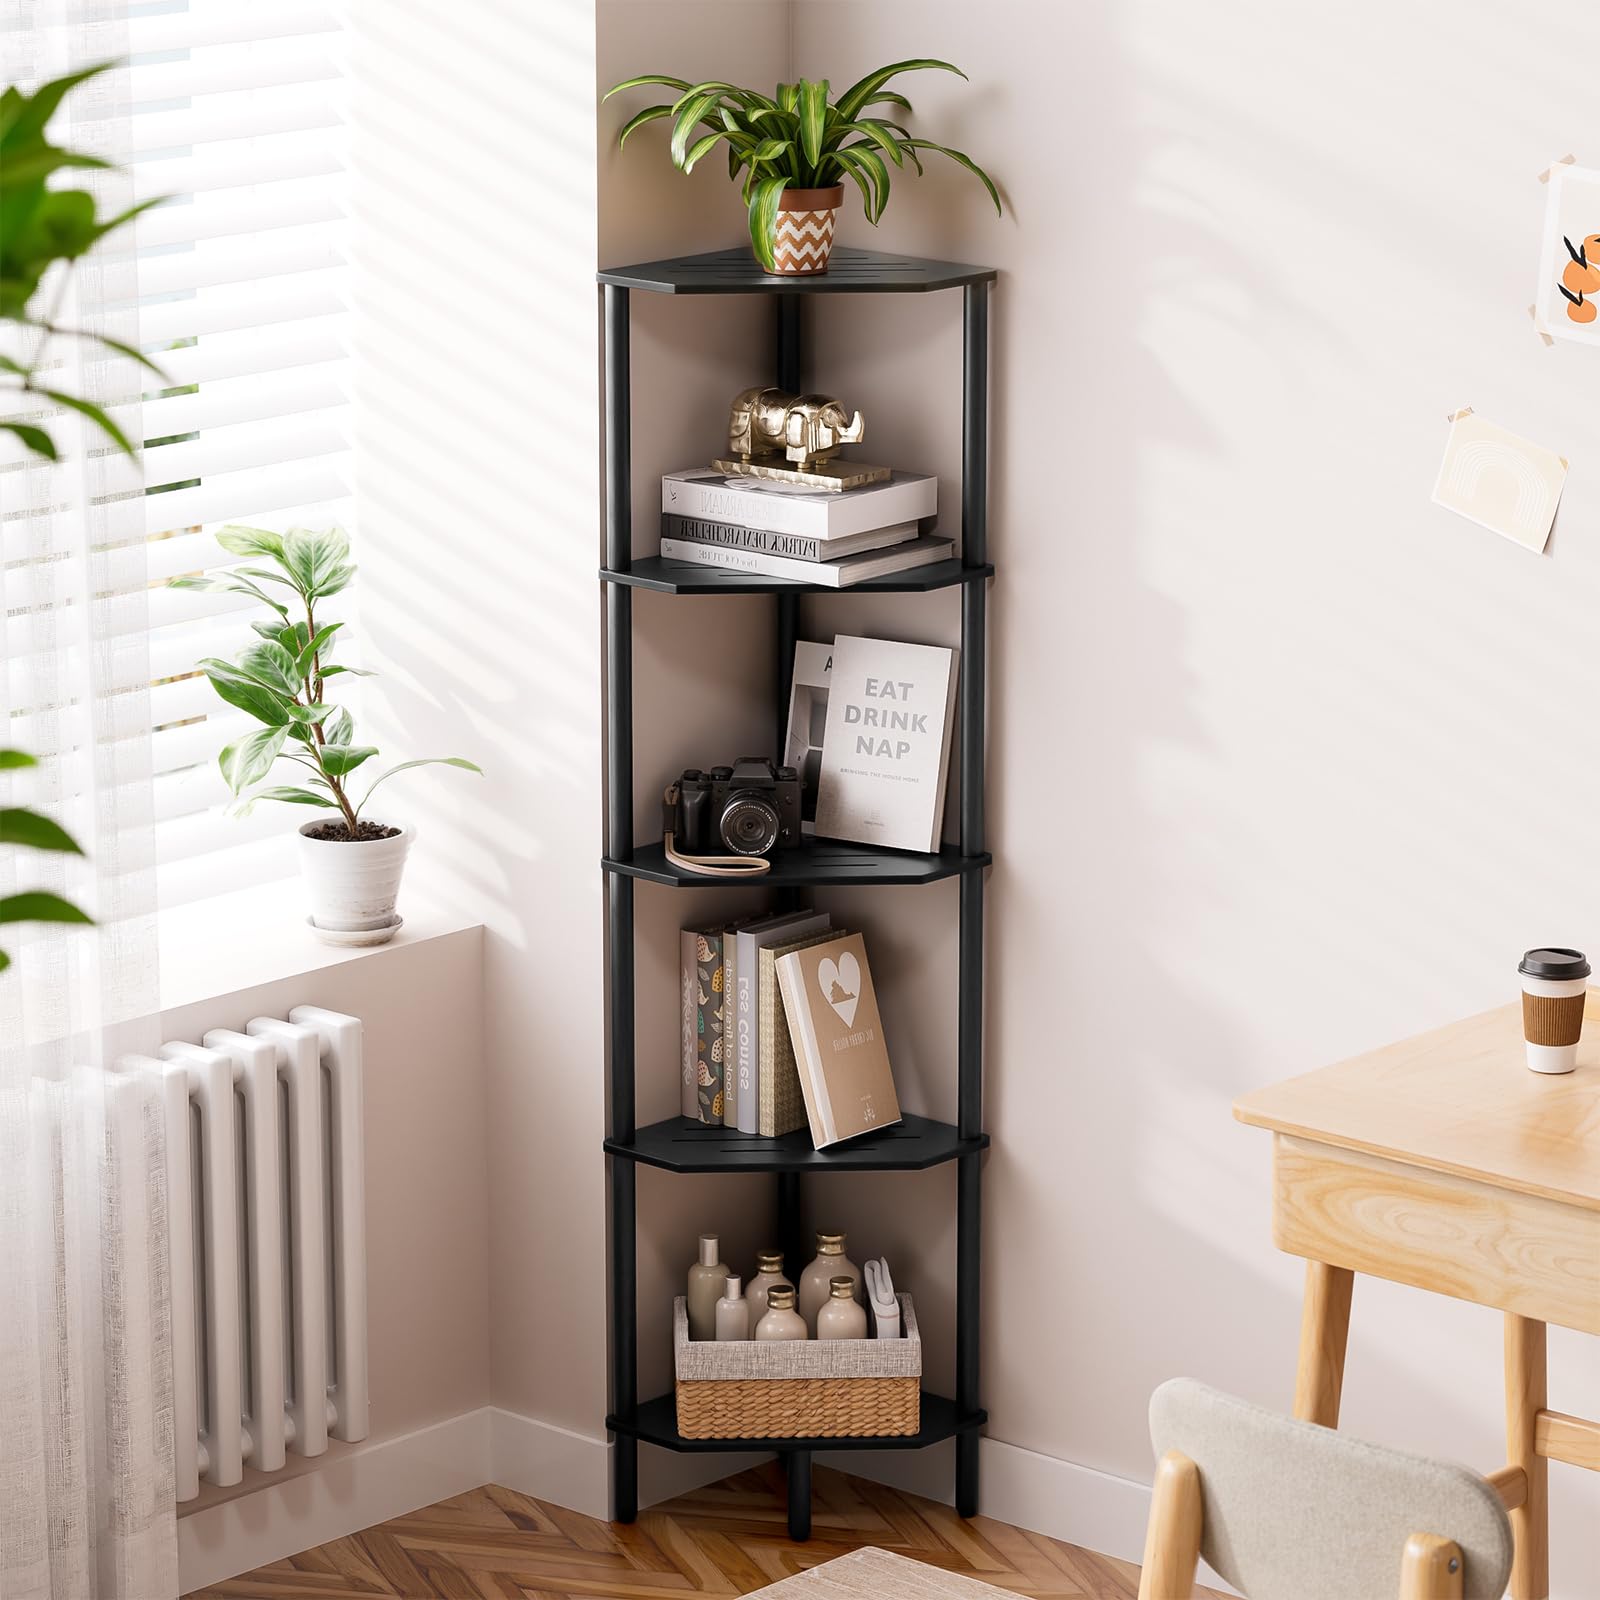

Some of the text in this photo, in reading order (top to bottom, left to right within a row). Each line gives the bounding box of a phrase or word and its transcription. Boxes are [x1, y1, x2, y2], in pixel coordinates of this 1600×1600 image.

[865, 678, 914, 701] EAT
[844, 704, 928, 734] DRINK
[855, 735, 911, 760] NAP
